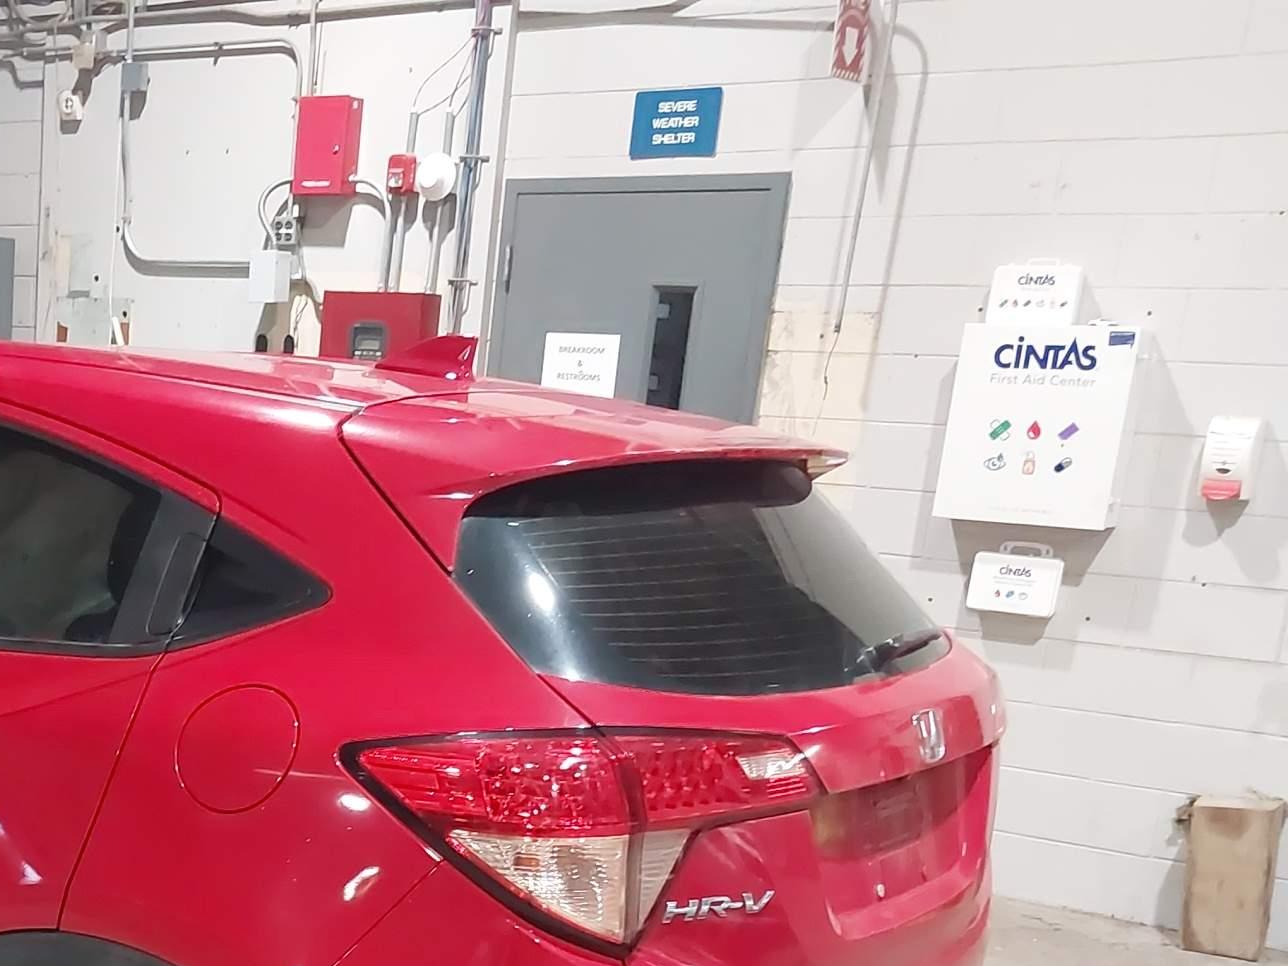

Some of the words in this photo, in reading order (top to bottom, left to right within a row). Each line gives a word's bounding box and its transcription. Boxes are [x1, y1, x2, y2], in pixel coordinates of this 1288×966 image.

[657, 100, 698, 113] SEVERE
[652, 116, 699, 129] WEATHER
[652, 132, 696, 145] SHELTER
[558, 346, 606, 355] BREAKROOM
[556, 372, 601, 382] RESTROOMS
[989, 373, 1018, 385] First
[1022, 374, 1046, 386] Aid
[1049, 374, 1097, 388] Center
[662, 890, 775, 924] HR-V
